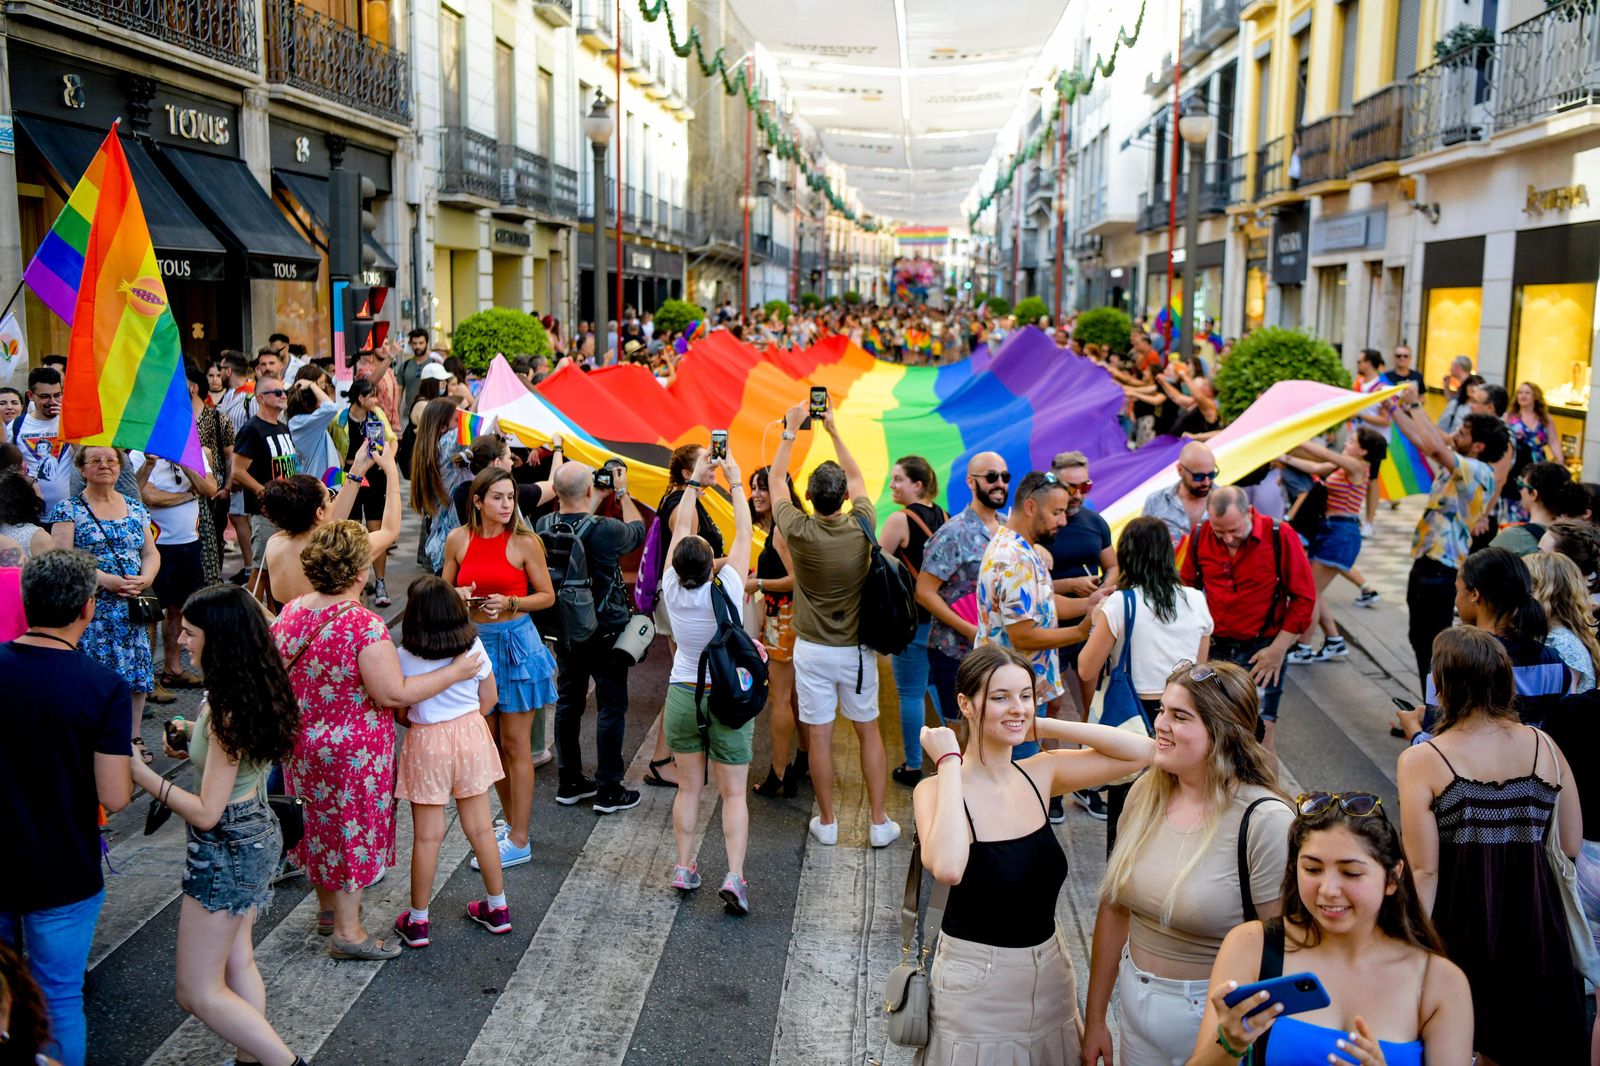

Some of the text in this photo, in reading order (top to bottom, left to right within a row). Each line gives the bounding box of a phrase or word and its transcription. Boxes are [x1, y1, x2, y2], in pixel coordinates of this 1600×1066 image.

[165, 104, 230, 145] TOUS
[157, 259, 191, 277] TOUS
[272, 262, 297, 279] TOUS
[362, 270, 381, 286] TOUS
